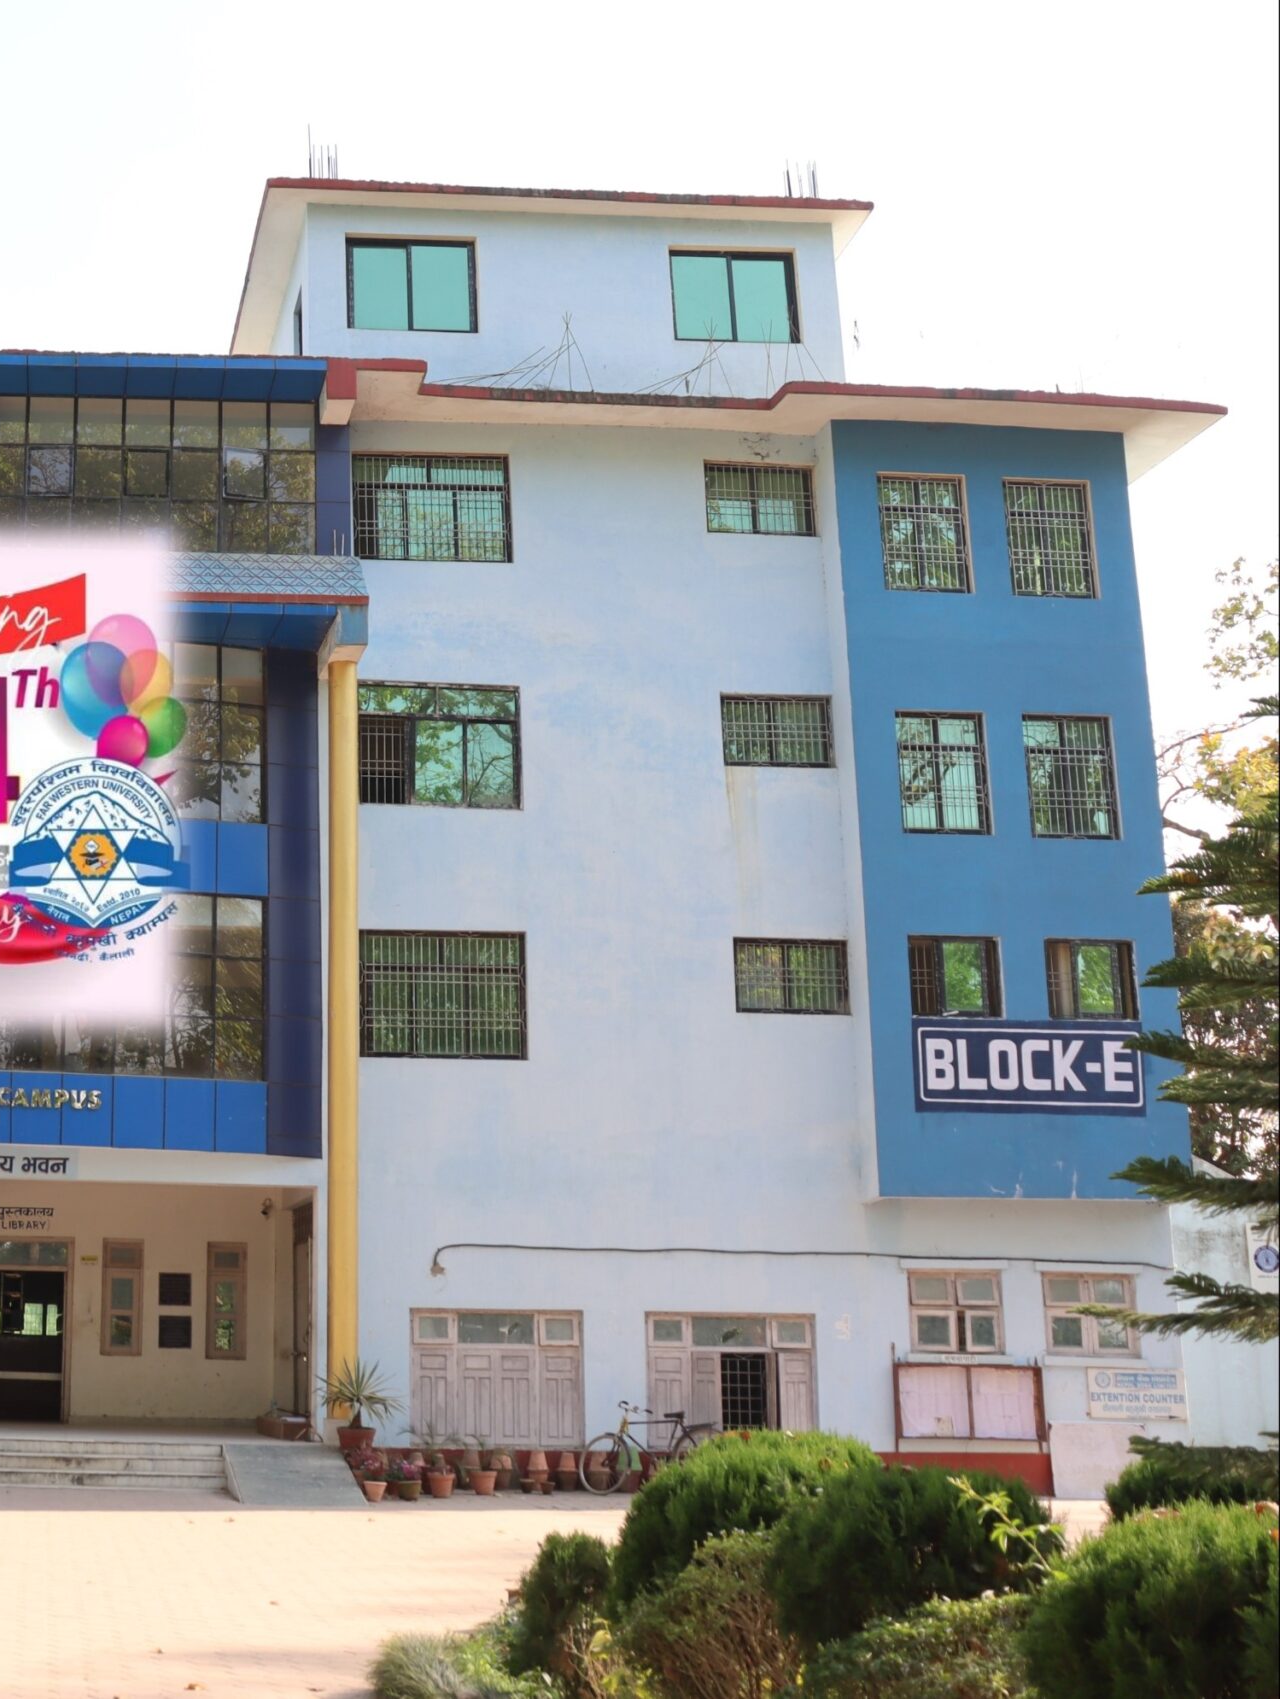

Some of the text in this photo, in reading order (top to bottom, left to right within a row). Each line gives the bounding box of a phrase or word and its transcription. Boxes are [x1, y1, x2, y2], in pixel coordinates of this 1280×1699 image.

[924, 1037, 1135, 1093] BLOCK-E
[22, 1156, 70, 1175] भवन
[1090, 1391, 1185, 1404] EXTENTION COUNTER
